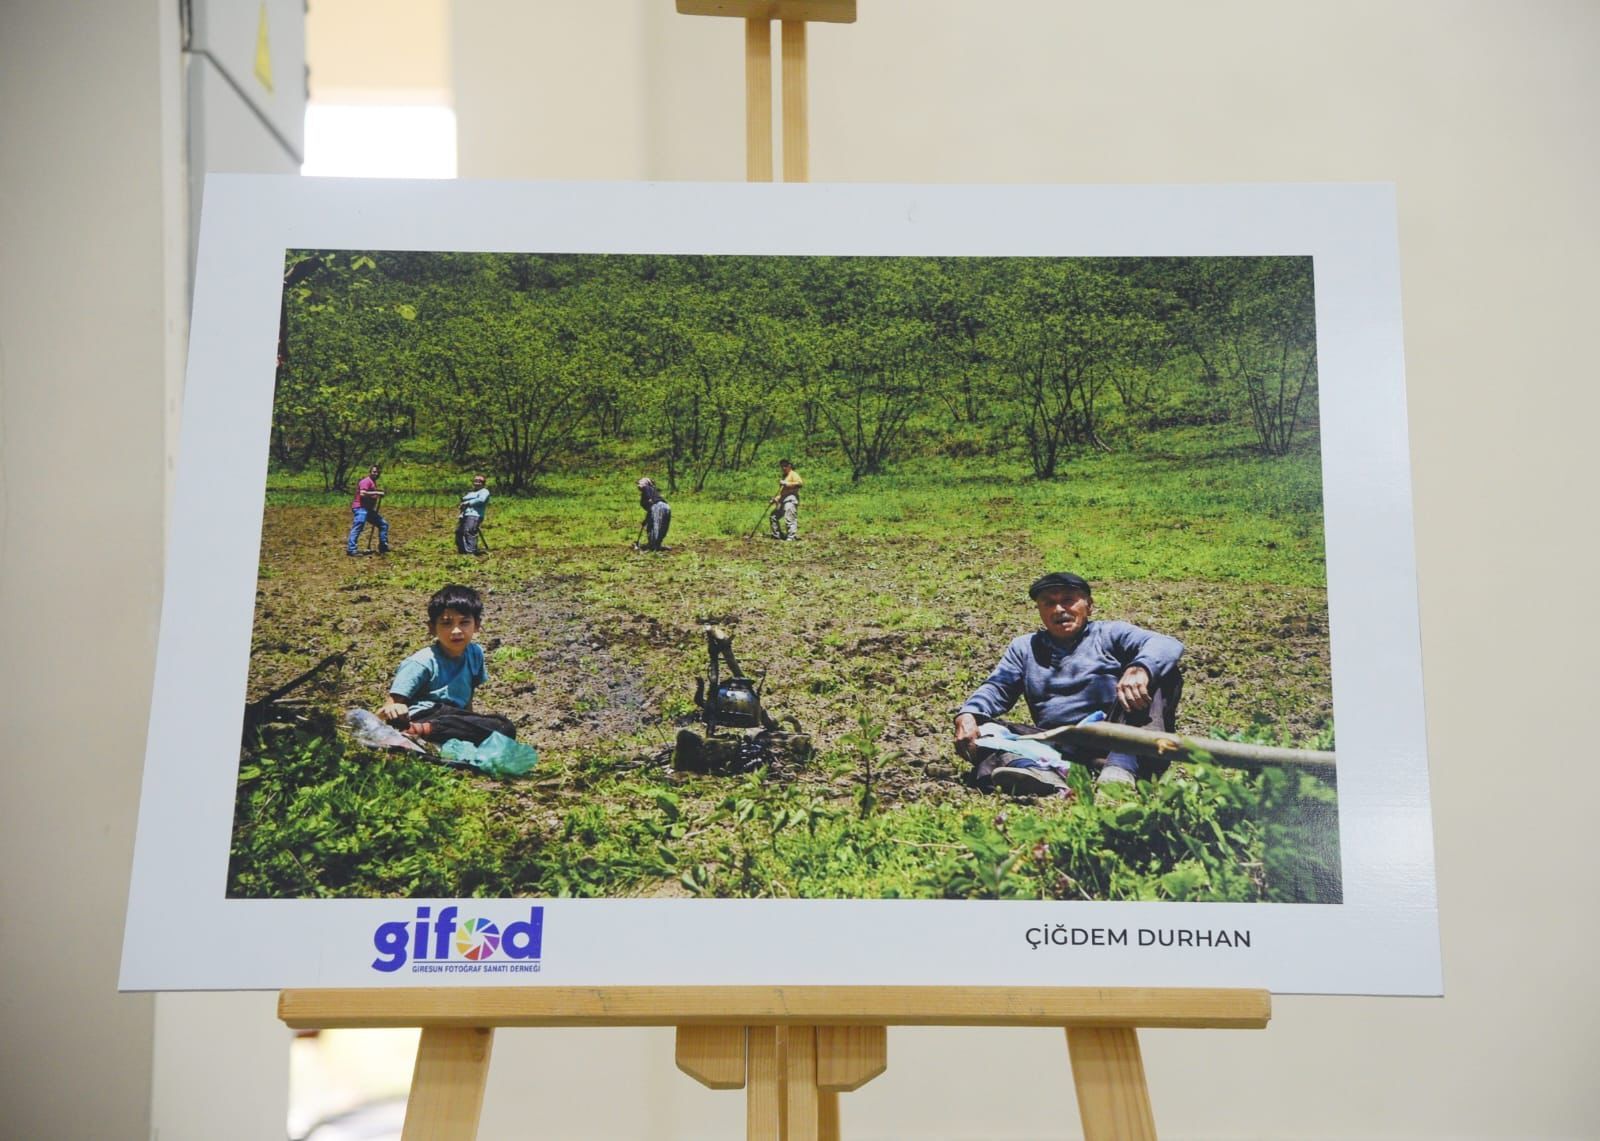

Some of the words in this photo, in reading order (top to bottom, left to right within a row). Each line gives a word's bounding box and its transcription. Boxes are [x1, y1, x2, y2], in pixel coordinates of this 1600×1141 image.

[371, 906, 544, 972] gifod
[1025, 923, 1127, 950] ÇİĞDEM
[1138, 928, 1251, 948] DURHAN
[445, 963, 482, 973] FOTOĞRAF
[484, 963, 508, 973] SANATI
